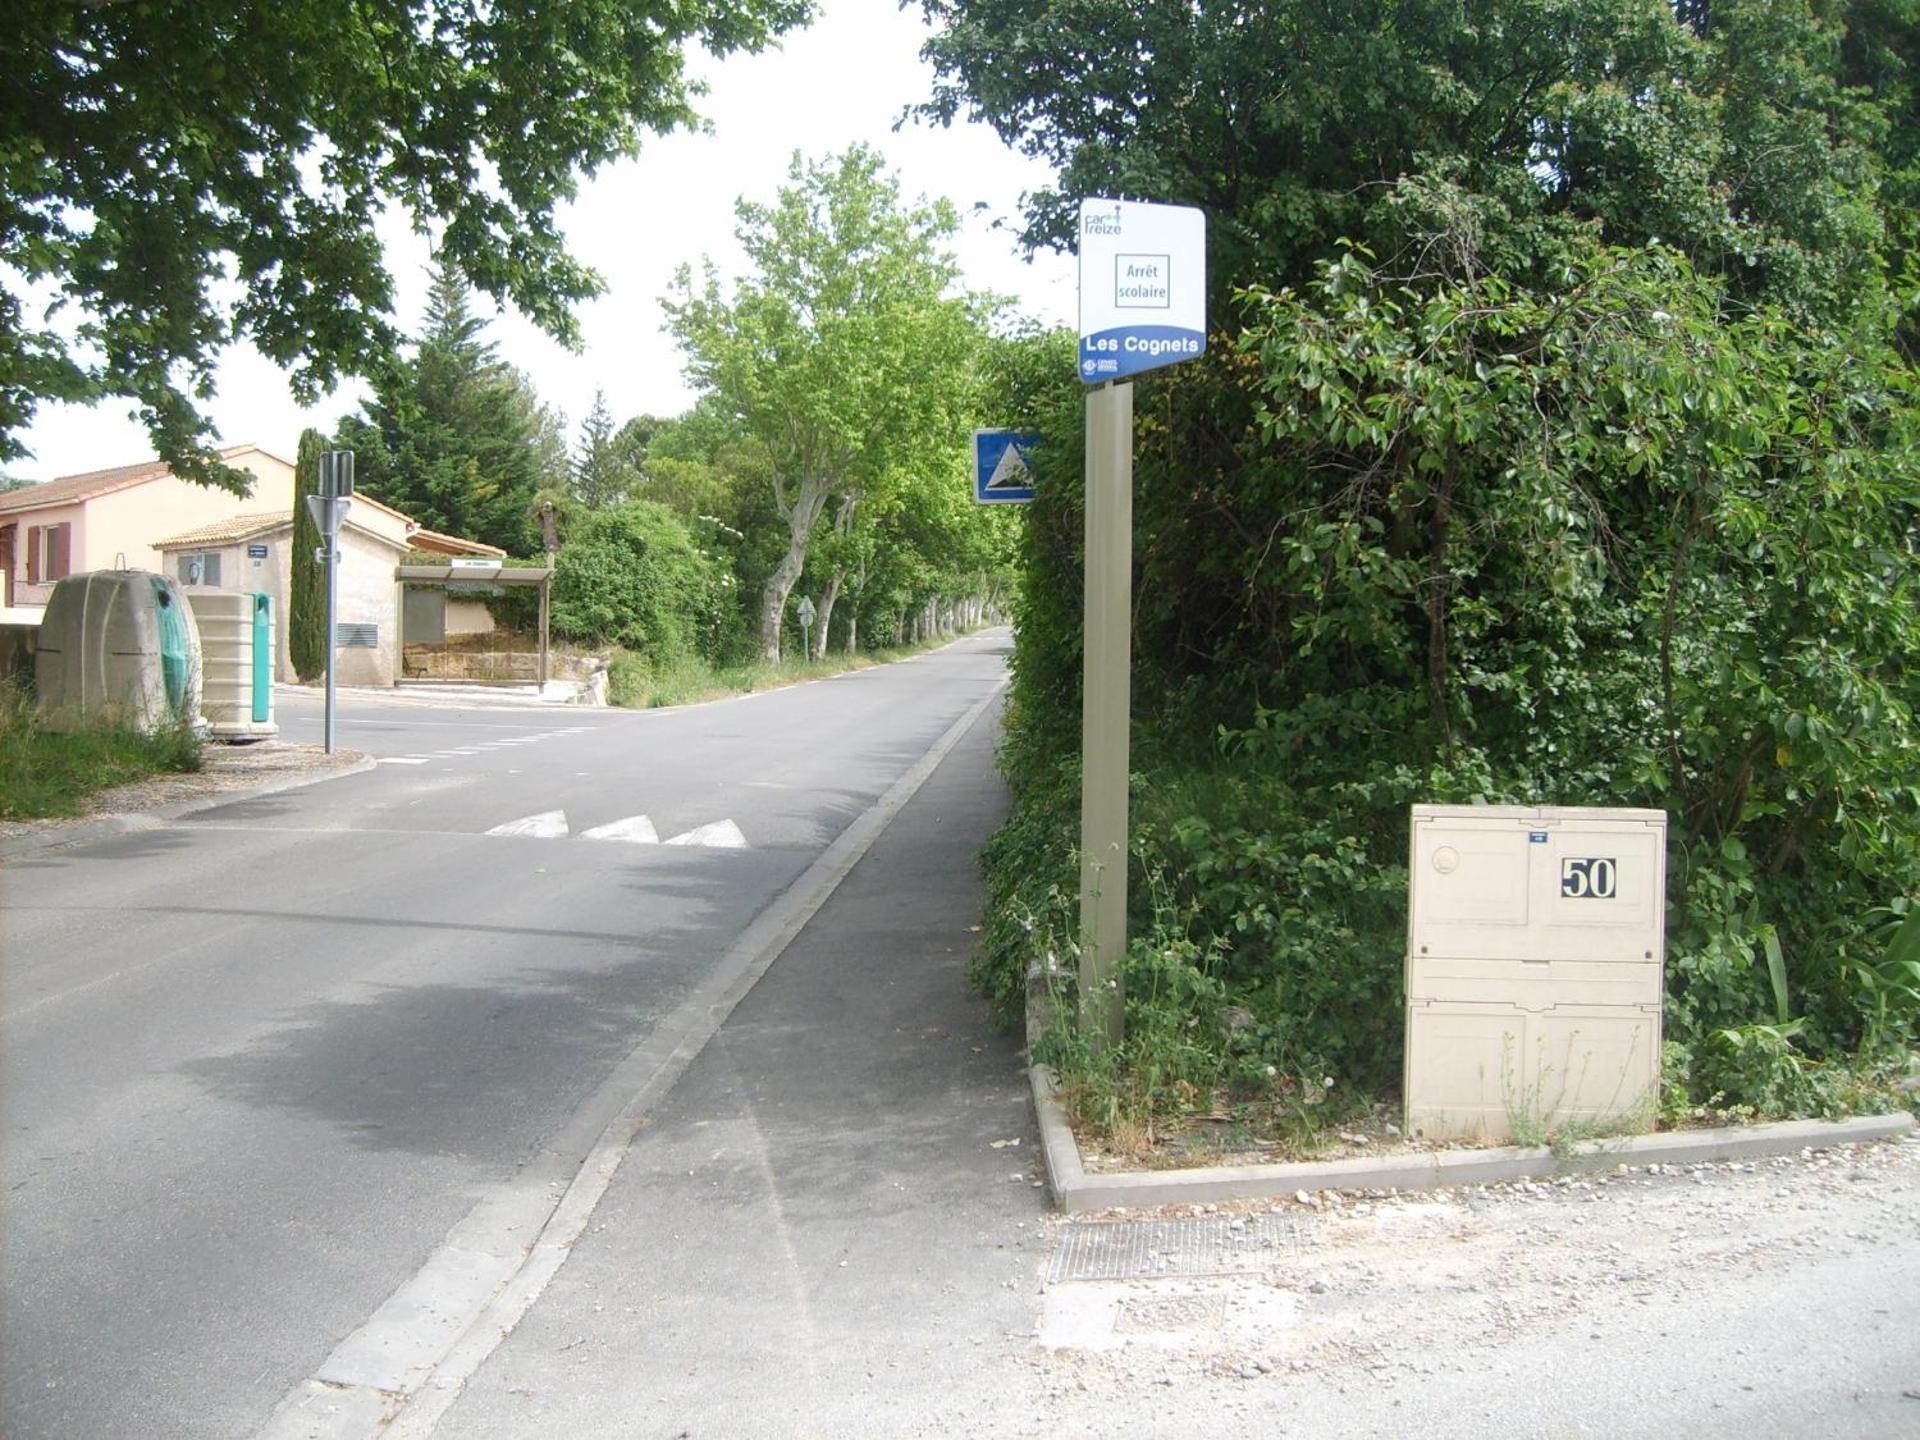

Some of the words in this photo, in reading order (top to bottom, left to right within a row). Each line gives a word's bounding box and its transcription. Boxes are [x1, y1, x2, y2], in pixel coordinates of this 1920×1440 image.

[1127, 264, 1158, 278] Arrêt
[1119, 285, 1166, 299] scolaire
[1086, 336, 1118, 352] Les
[1124, 336, 1199, 355] Cognets
[1562, 858, 1616, 897] 50
